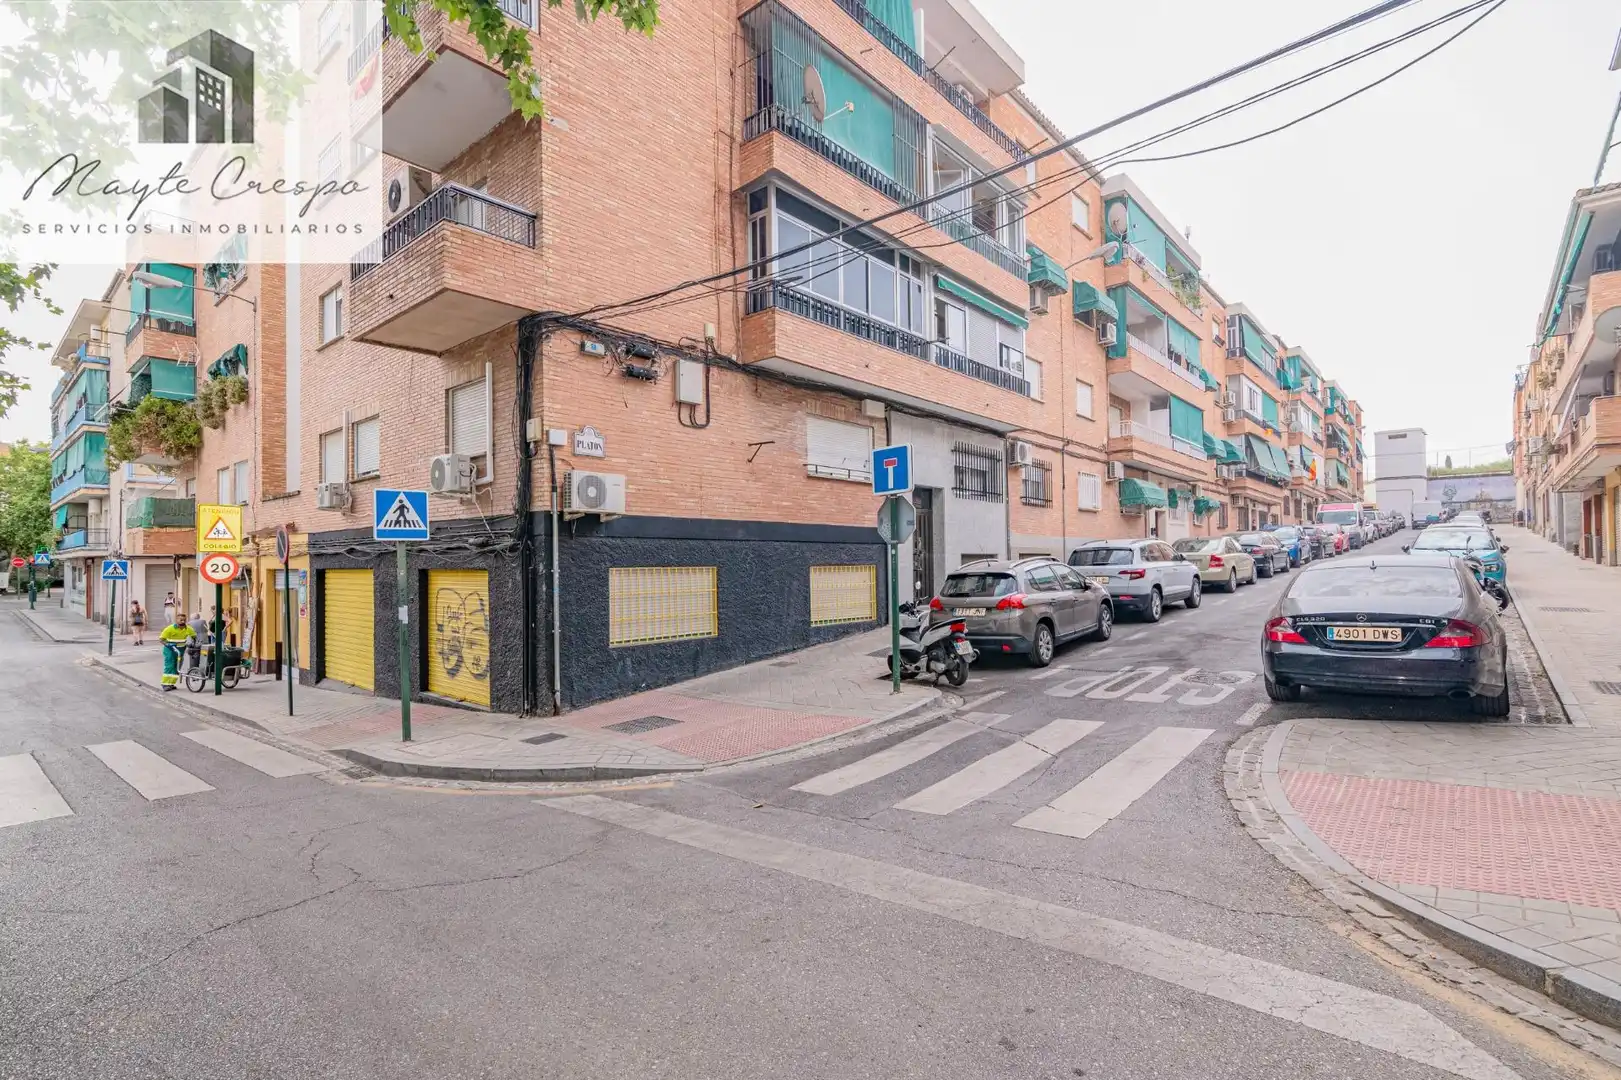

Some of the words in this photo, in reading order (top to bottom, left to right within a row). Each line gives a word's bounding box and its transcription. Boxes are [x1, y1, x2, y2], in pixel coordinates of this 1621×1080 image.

[211, 563, 231, 573] 20
[1335, 628, 1367, 639] 4901
[1373, 629, 1398, 640] DWS
[1044, 665, 1257, 706] STOP
